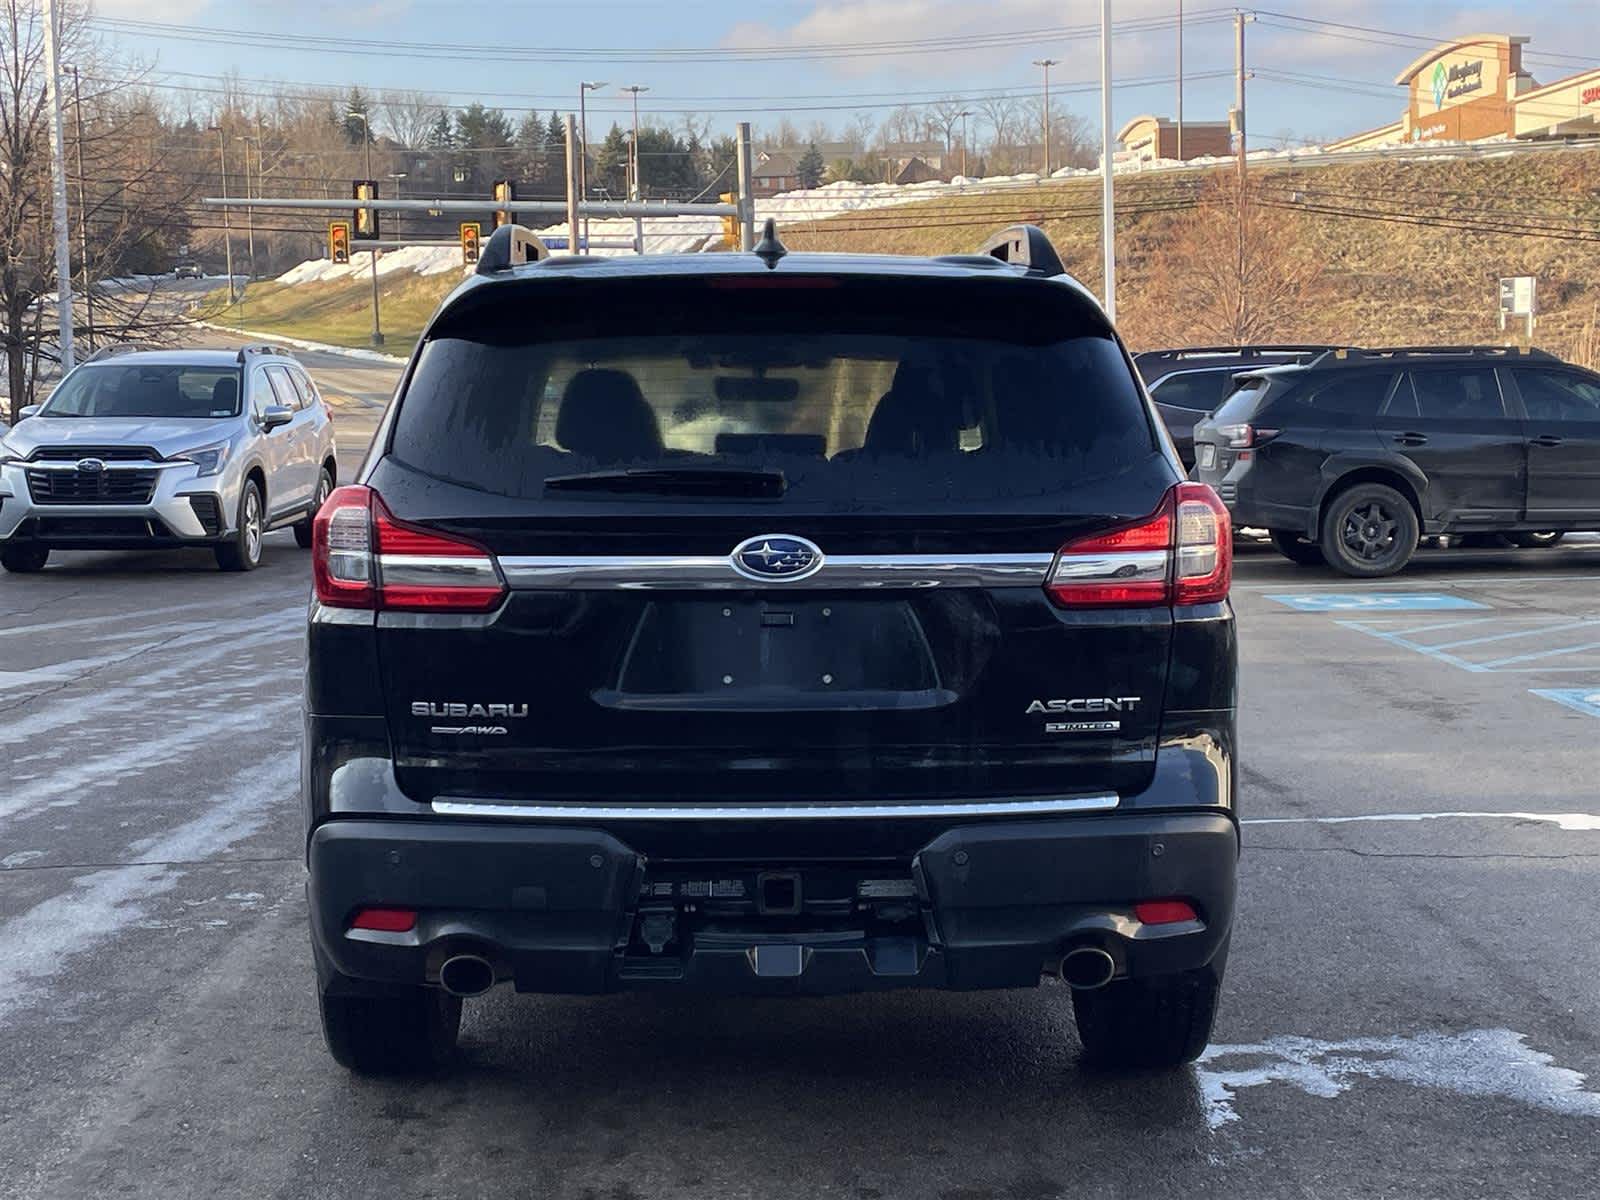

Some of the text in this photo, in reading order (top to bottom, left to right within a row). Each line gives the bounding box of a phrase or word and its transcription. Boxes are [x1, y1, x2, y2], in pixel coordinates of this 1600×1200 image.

[411, 702, 529, 717] SUBARU
[1025, 697, 1141, 713] ASCENT
[459, 726, 508, 735] AWD
[1053, 721, 1118, 732] LIMITED
